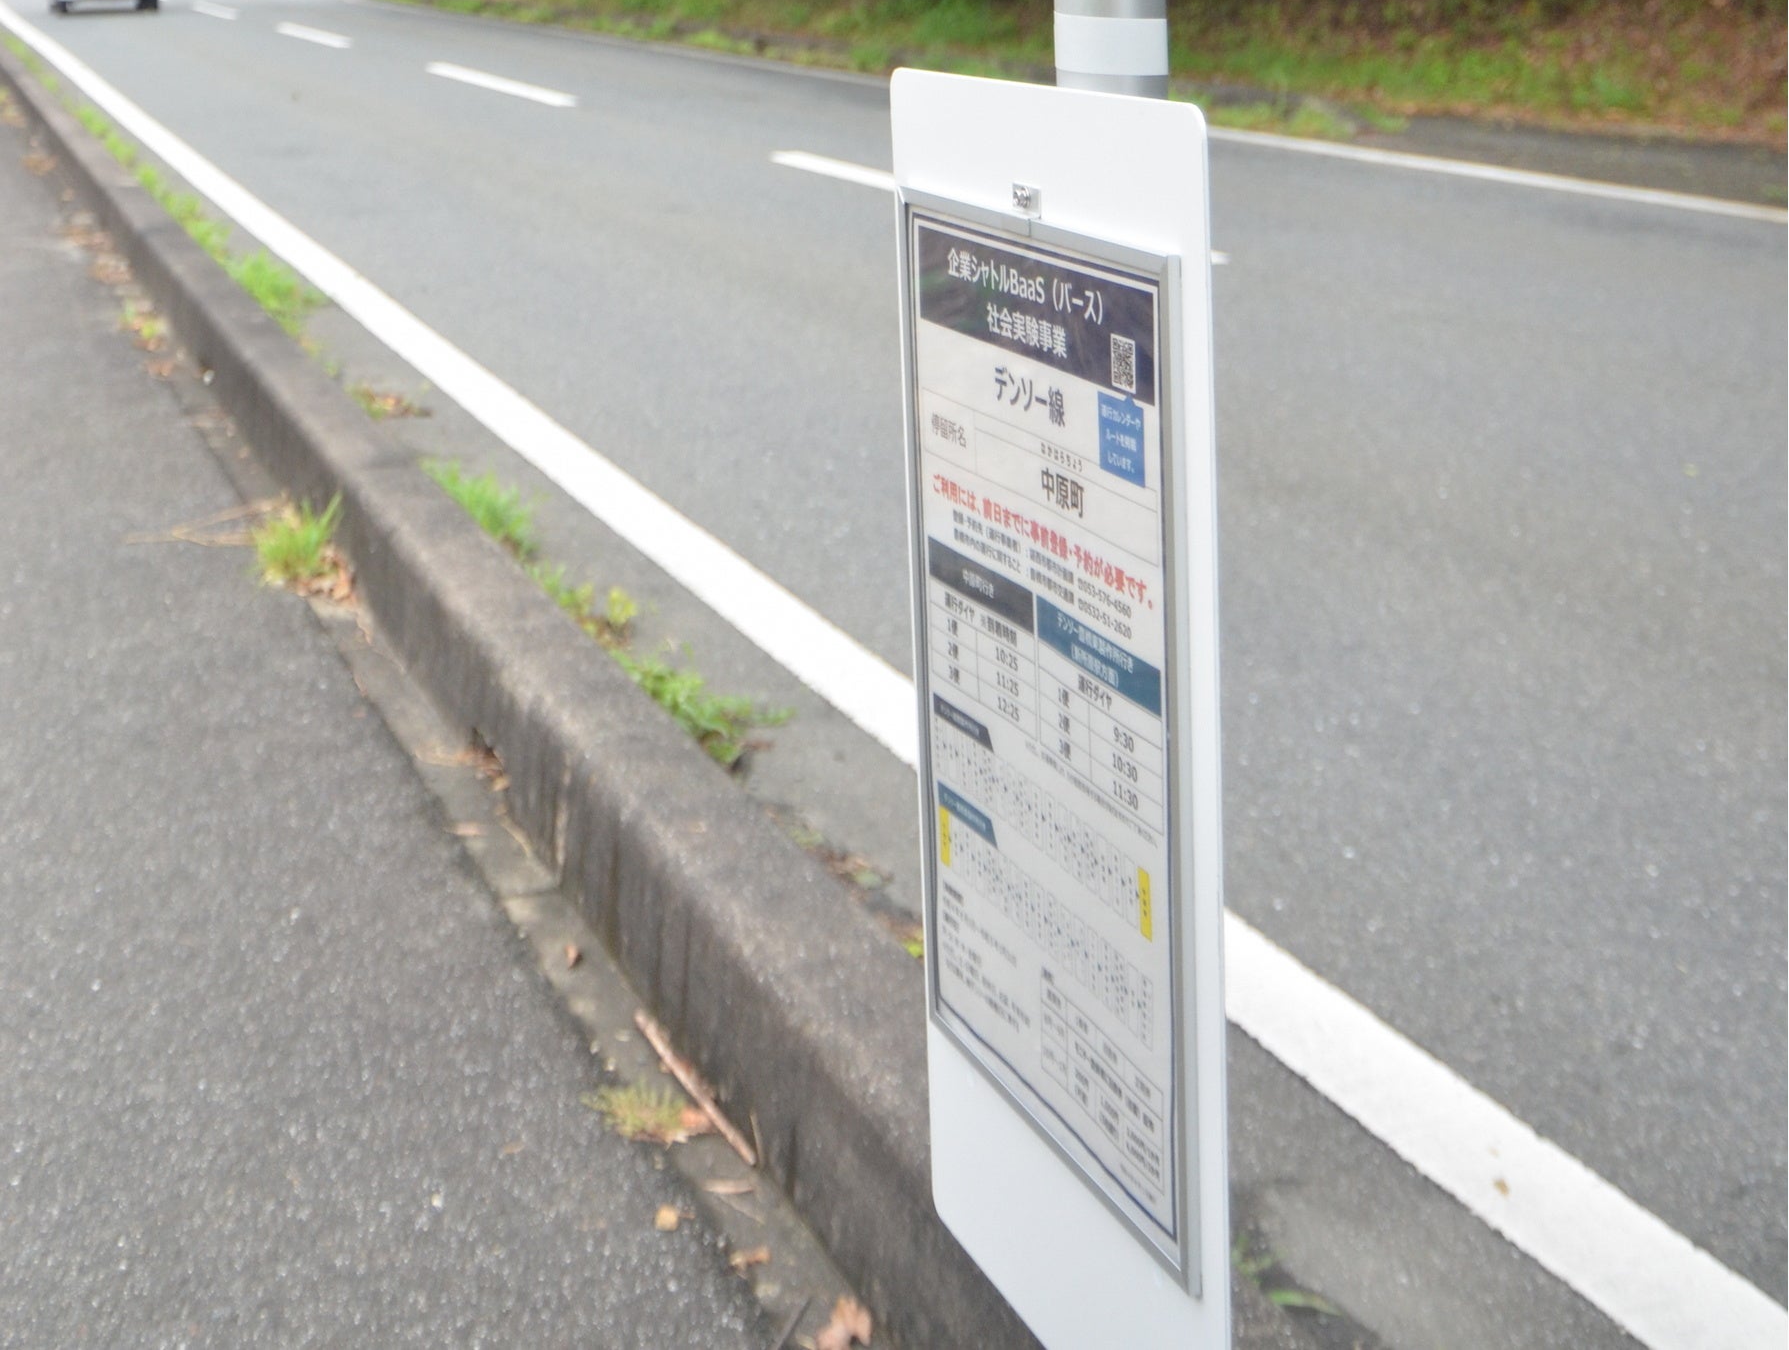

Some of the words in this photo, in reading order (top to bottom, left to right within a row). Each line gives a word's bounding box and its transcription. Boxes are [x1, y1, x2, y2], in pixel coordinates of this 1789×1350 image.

[986, 302, 1067, 359] 社会実験事業
[994, 366, 1066, 427] デンソー線
[1041, 466, 1085, 519] 中原町
[995, 646, 1018, 671] 10:25
[996, 671, 1019, 697] 11:25
[997, 696, 1020, 722] 12:25
[1113, 727, 1135, 753] 9:30
[1112, 753, 1138, 782] 10:30
[1113, 780, 1138, 810] 11:30
